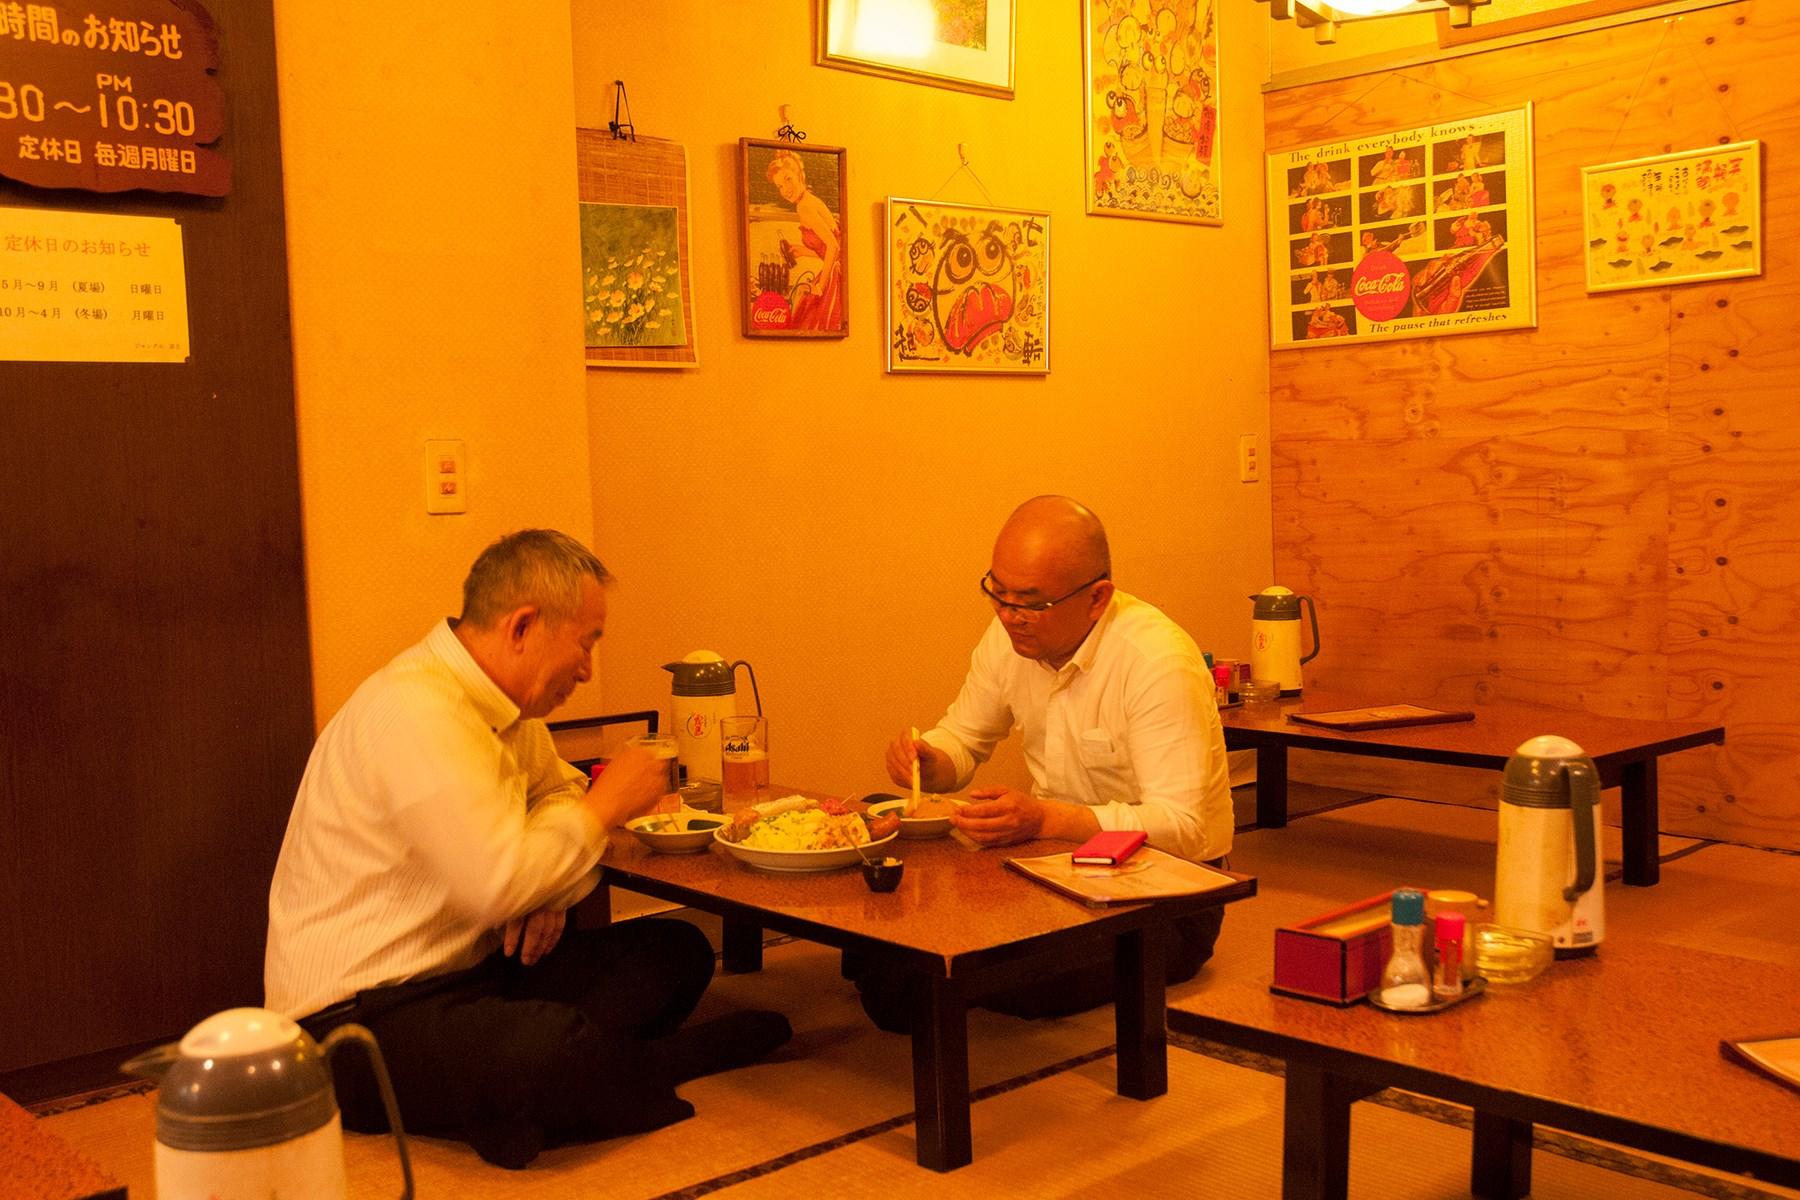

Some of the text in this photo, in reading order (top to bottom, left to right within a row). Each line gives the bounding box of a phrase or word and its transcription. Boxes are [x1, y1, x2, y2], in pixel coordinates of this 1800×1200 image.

[0, 2, 183, 60] 時間のお知らせ
[96, 73, 133, 93] PM
[19, 135, 196, 174] 定休日 毎週月曜日
[1289, 151, 1310, 163] The
[1316, 145, 1350, 159] drink
[1357, 131, 1425, 152] everybody
[5, 234, 151, 257] 定休日のお知らせ
[130, 284, 162, 295] 日曜日
[1354, 272, 1406, 297] Coca-Cola
[132, 310, 165, 321] 月曜日
[1370, 312, 1508, 334] The pause that refreshes
[725, 742, 749, 752] Asahi
